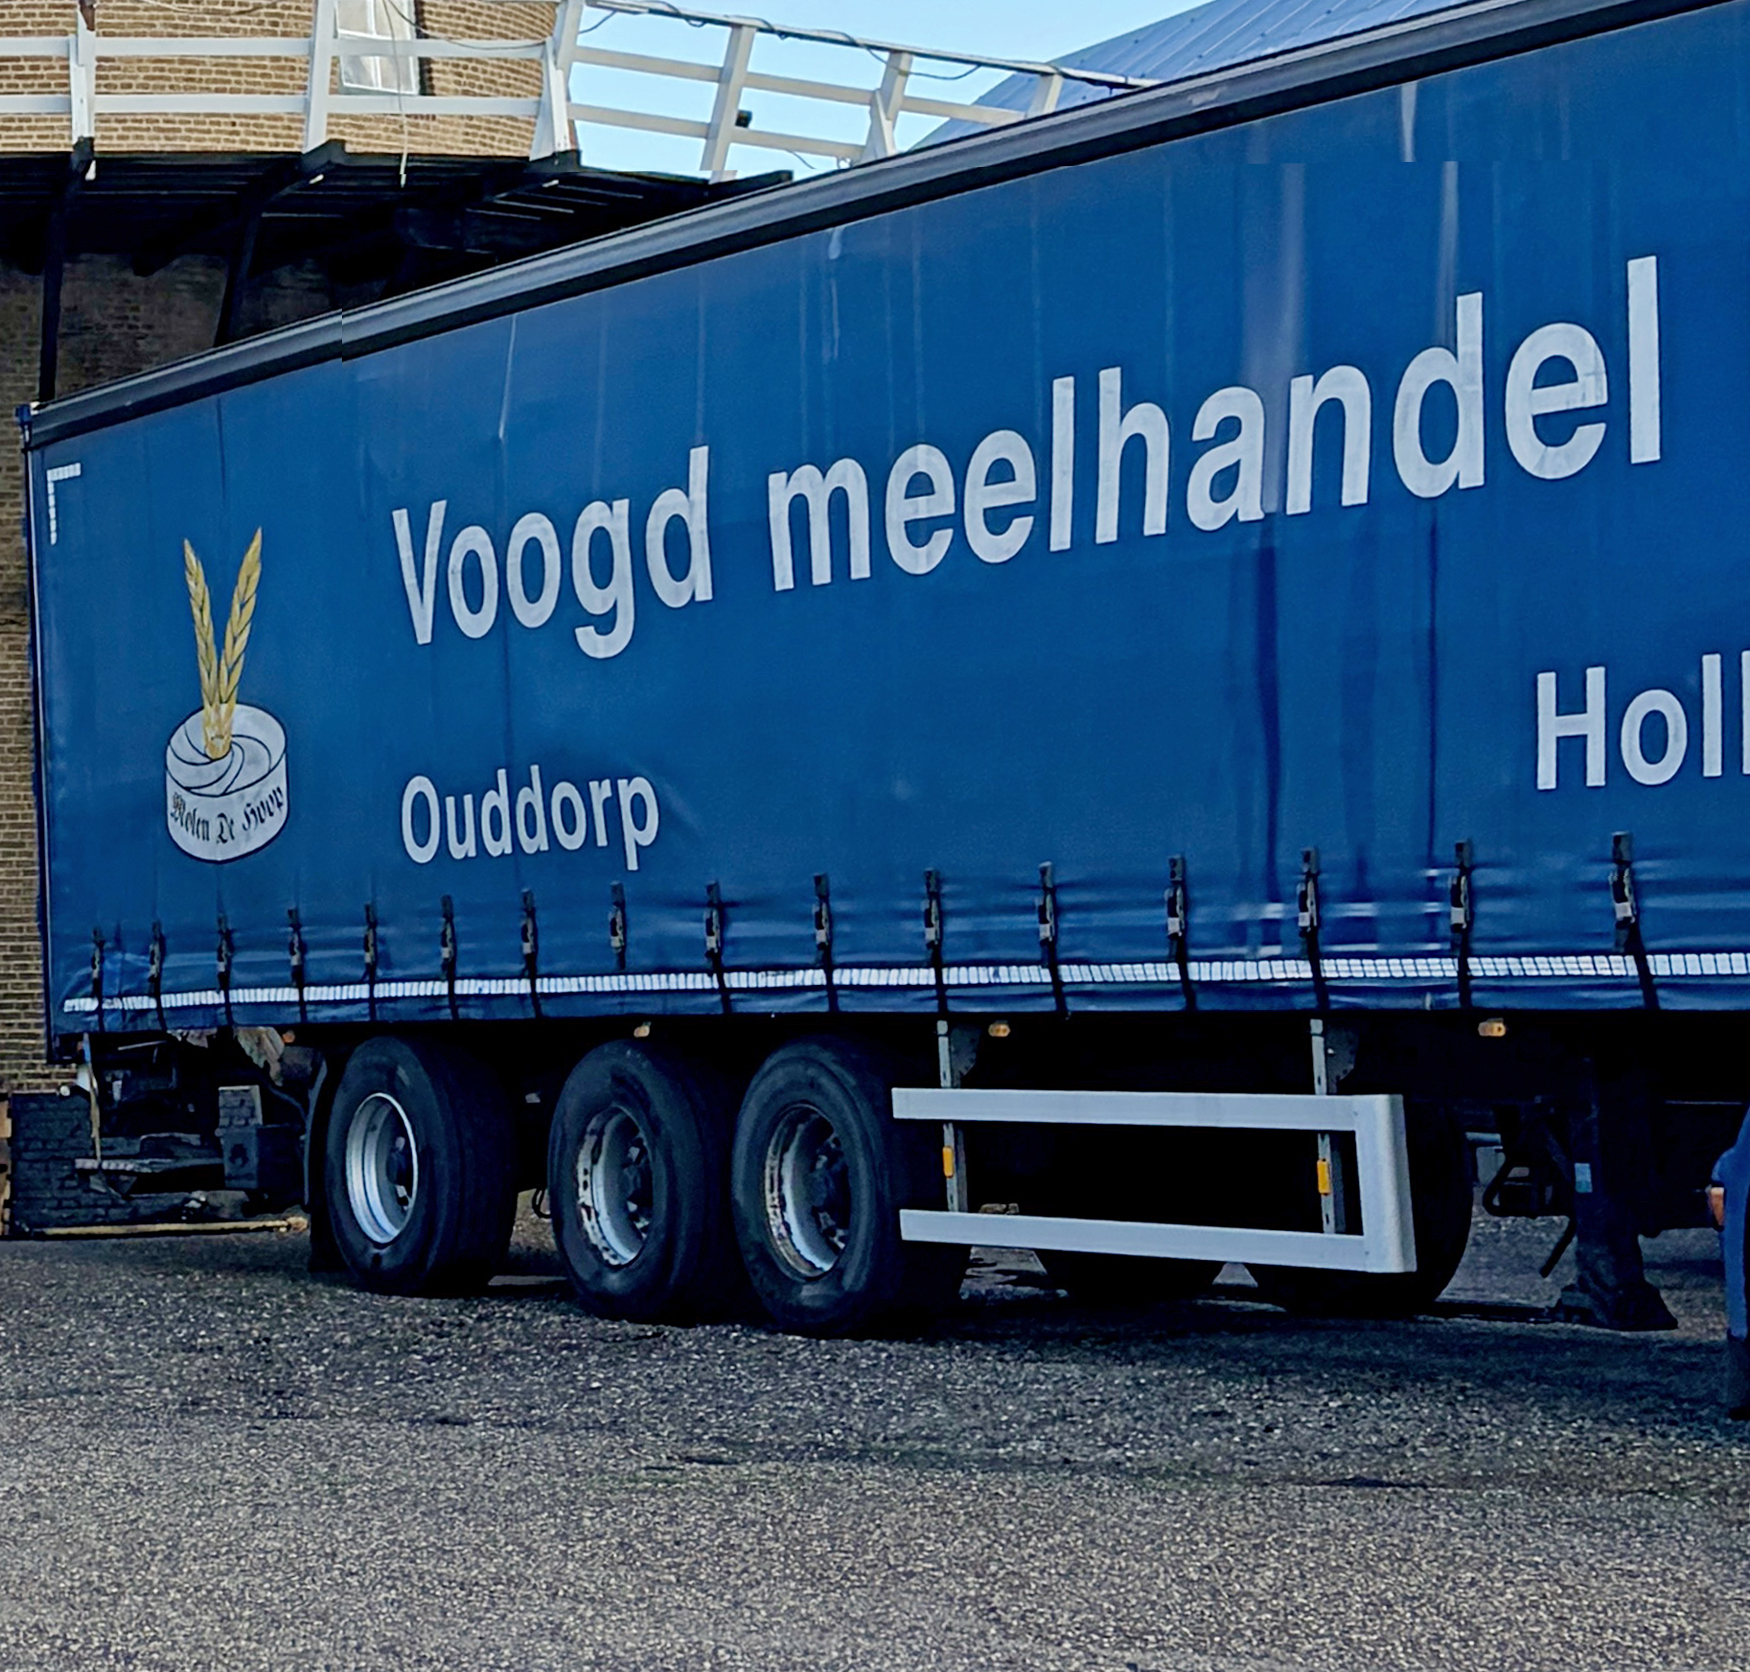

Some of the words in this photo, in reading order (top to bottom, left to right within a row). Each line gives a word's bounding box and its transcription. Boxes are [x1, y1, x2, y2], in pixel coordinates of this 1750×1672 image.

[392, 445, 713, 659] Voogd
[768, 255, 1662, 591] meelhandel
[170, 791, 210, 842] Molen
[216, 812, 235, 845] De
[401, 764, 660, 871] Ouddorp
